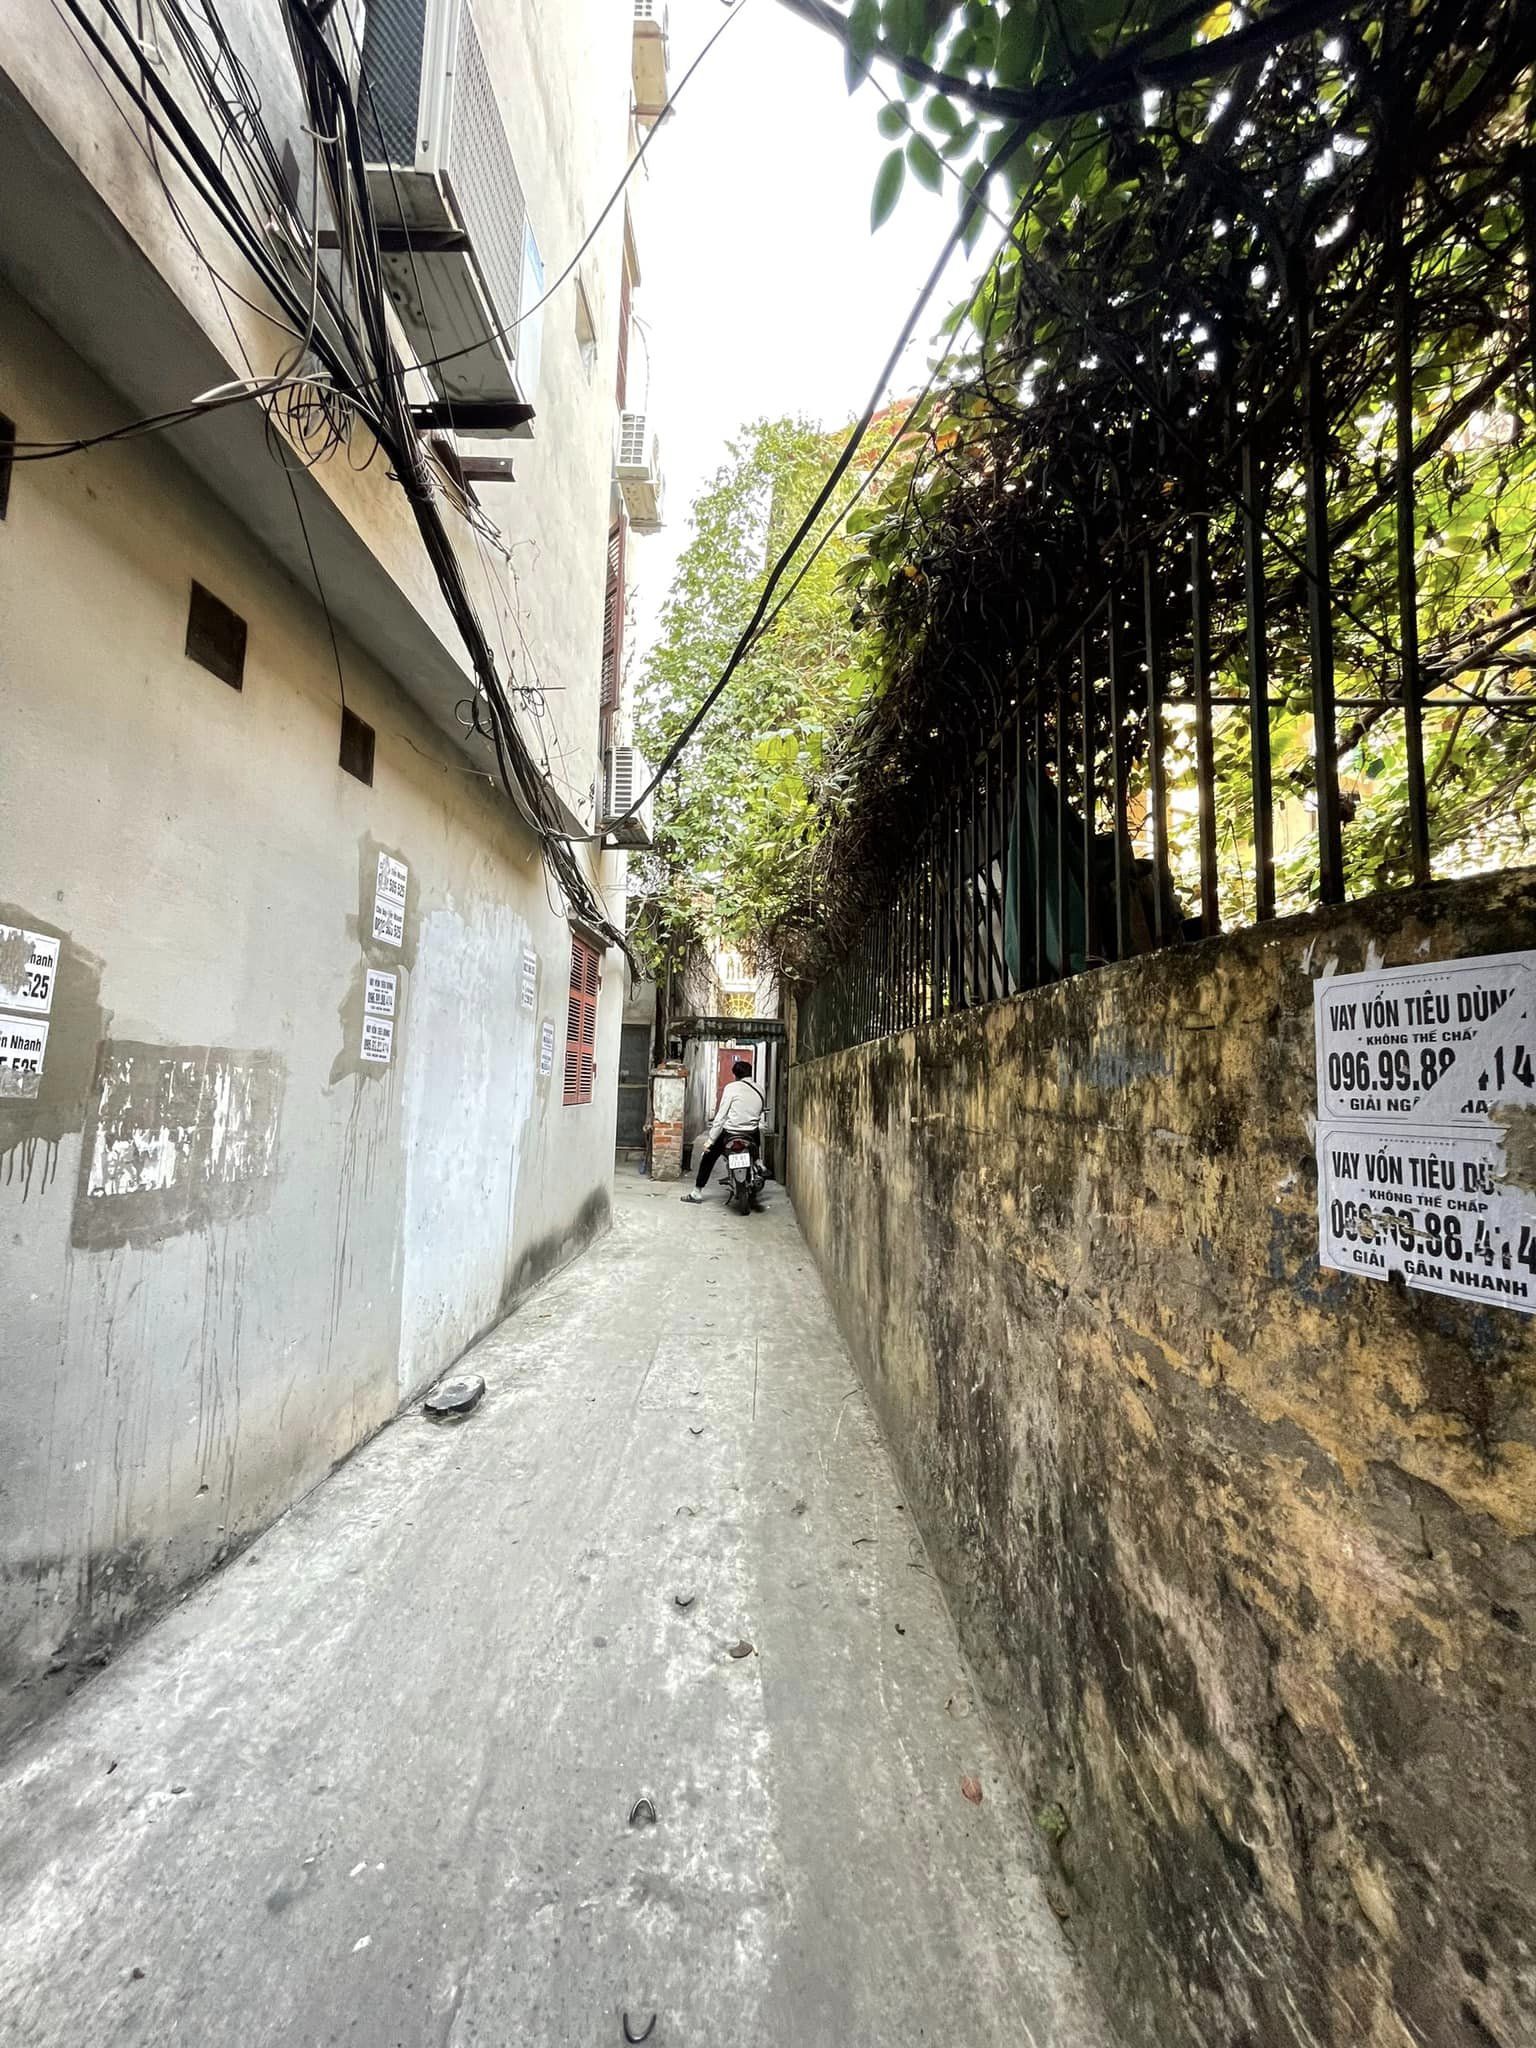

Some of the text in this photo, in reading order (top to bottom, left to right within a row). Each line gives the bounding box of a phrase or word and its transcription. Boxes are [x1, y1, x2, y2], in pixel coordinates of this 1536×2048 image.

[1330, 984, 1526, 1031] VAY VỐN TIÊU DÙN
[10, 1034, 42, 1052] Nhanh
[1366, 1033, 1408, 1046] KHÔNG
[1442, 1026, 1478, 1042] CHẤ
[1350, 1094, 1381, 1111] GIẢI
[1332, 1150, 1360, 1180] VAY
[1365, 1145, 1403, 1185] VỐN
[1408, 1152, 1456, 1191] TIÊU
[1369, 1188, 1412, 1204] KHÔNG
[1353, 1247, 1528, 1298] GIẢI GÂN NHANH
